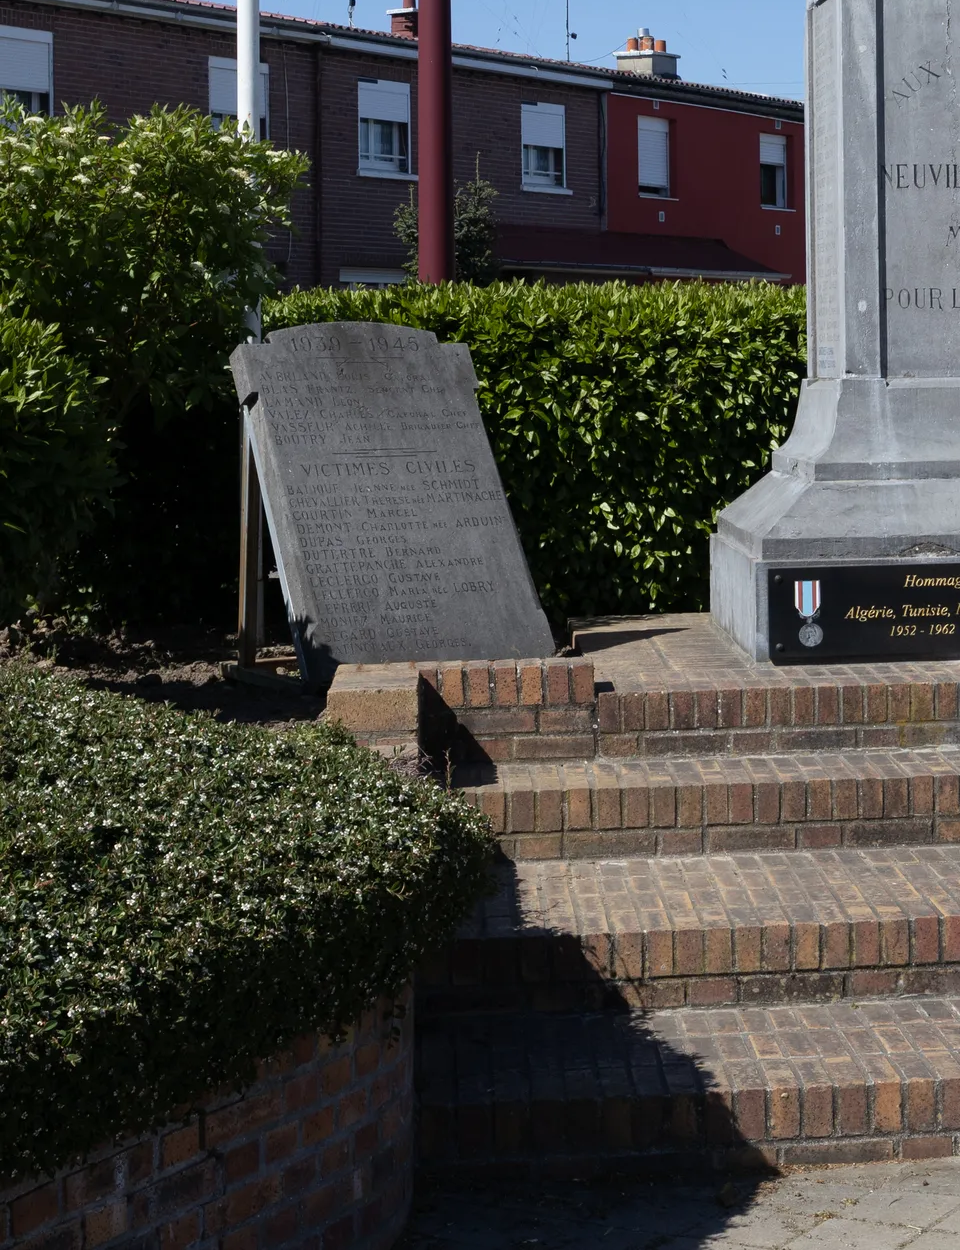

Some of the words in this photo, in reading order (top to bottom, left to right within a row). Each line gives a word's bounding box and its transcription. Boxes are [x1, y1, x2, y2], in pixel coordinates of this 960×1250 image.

[892, 61, 941, 108] AUX
[883, 287, 944, 311] POUR
[291, 336, 341, 352] 1939
[369, 336, 420, 352] 1945
[271, 422, 335, 433] VASSEUR
[400, 420, 452, 431] BRIGADIER
[274, 434, 327, 446] BOUTRY
[340, 433, 372, 444] JEAN
[300, 462, 391, 477] VICTIMES
[405, 459, 476, 474] CIVILES
[354, 483, 395, 493] JEANNE
[422, 478, 480, 491] SCHMIDT
[289, 496, 360, 508] CHEVALLIER
[427, 490, 503, 503] MARTINACHE
[292, 509, 353, 521] COURTIN
[367, 508, 418, 518] MARCEL
[296, 523, 351, 535] DEMONT
[361, 521, 429, 531] CHARLOTTE
[299, 536, 343, 548] DUPAS
[302, 549, 376, 561] DUTERTRE
[385, 546, 442, 557] BERNARD
[416, 557, 484, 569] ALEXANDRE
[388, 572, 441, 584] GUSTAVE
[389, 586, 428, 597] MARIA
[453, 580, 497, 593] LOBRY
[385, 599, 438, 611] AUGUSTE
[380, 613, 433, 625] MAURICE
[844, 605, 896, 622] Algérie,
[902, 604, 950, 618] Tunisie,
[324, 629, 377, 643] SEGARD
[386, 626, 440, 639] GUSTAVE
[890, 625, 916, 636] 1952
[929, 624, 956, 635] 1962
